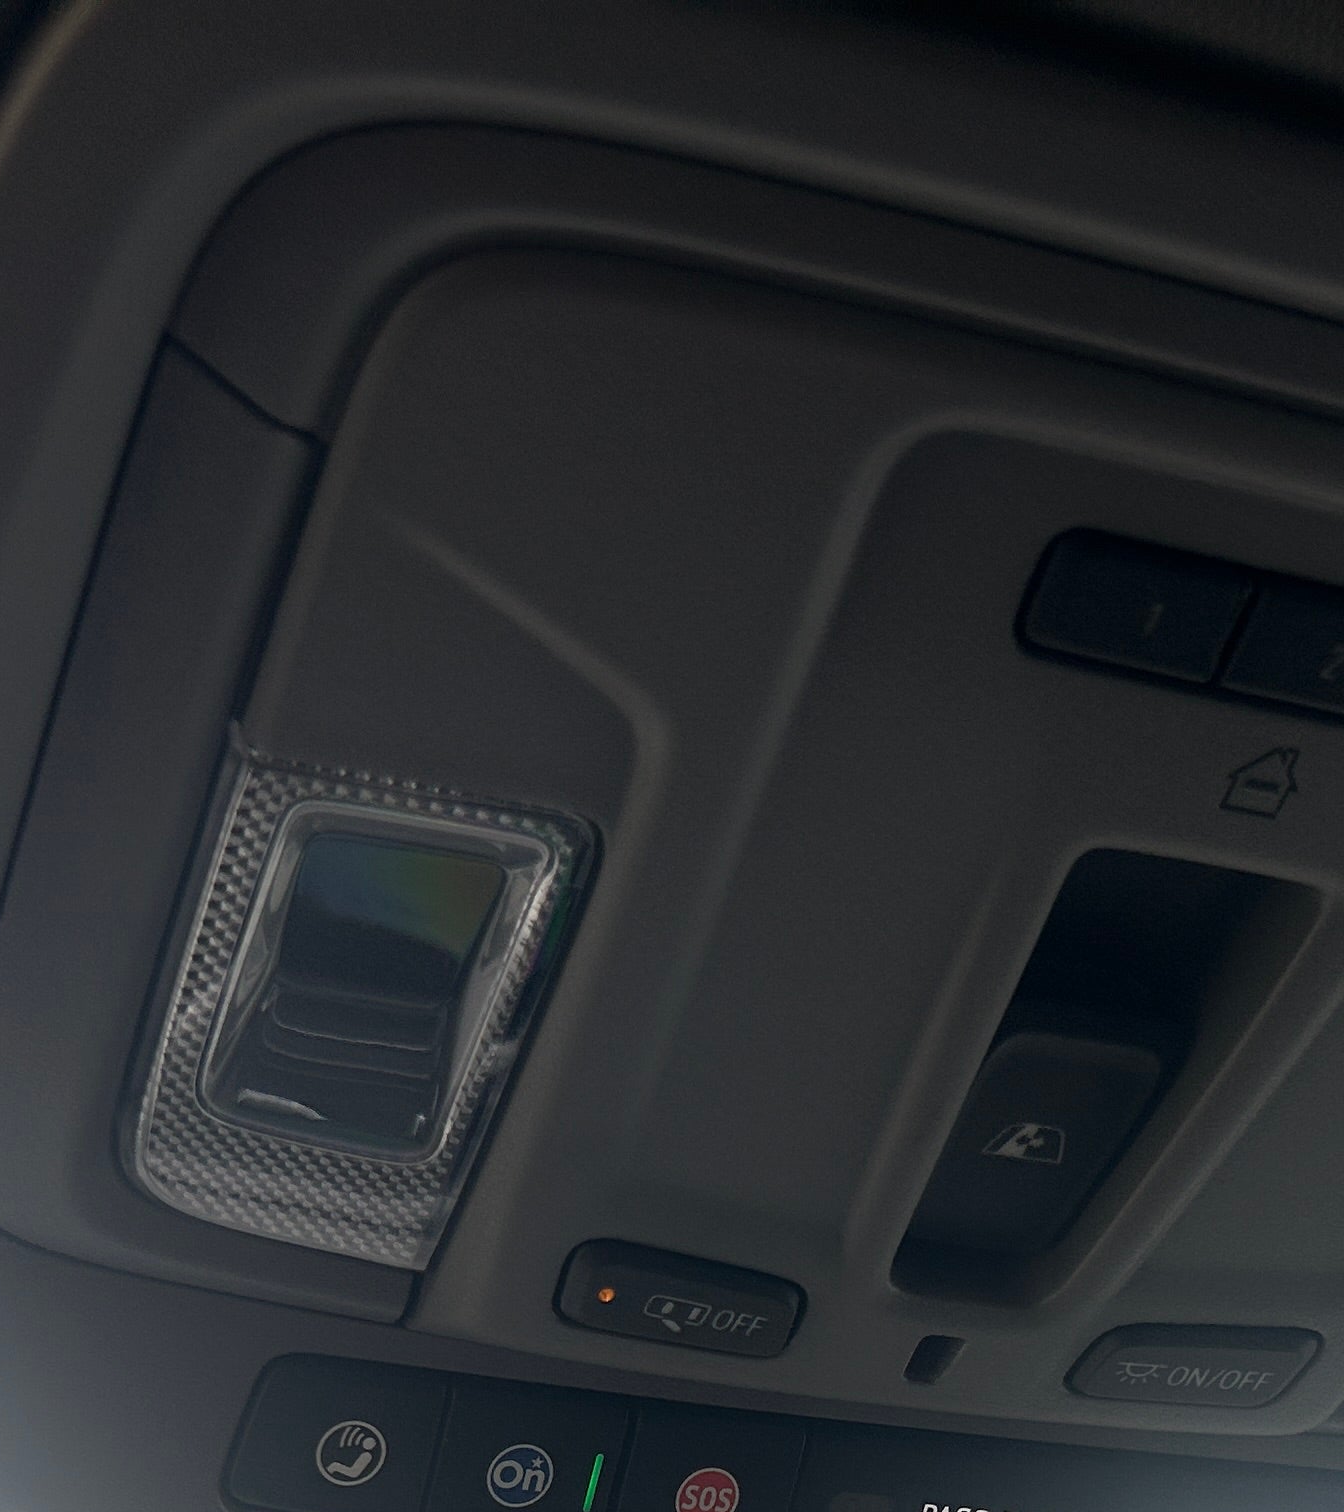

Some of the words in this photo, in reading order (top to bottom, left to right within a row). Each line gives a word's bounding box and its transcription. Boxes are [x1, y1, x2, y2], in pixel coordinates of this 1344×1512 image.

[1141, 602, 1164, 635] 1
[712, 1309, 768, 1336] OFF
[1166, 1367, 1275, 1391] ON/OFF
[493, 1459, 546, 1492] On
